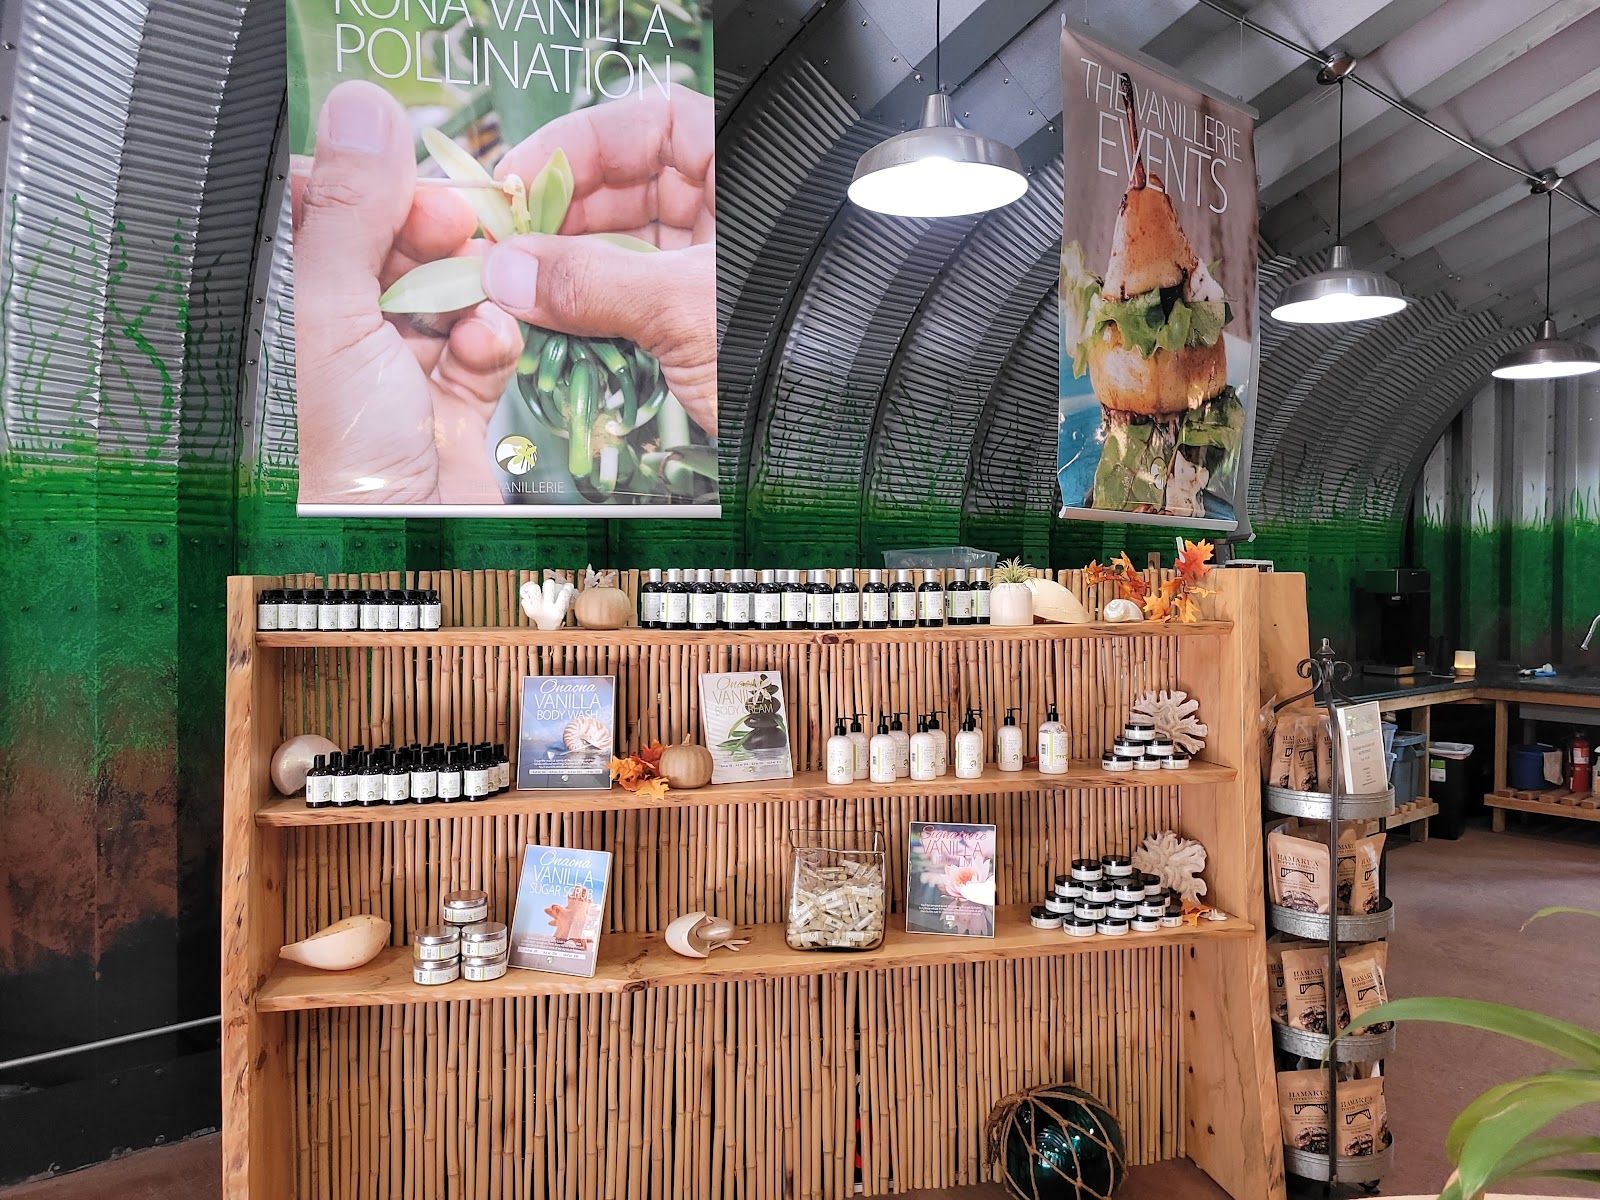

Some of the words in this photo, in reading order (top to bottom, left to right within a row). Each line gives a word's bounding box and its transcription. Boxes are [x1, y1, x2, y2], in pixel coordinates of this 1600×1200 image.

[490, 0, 675, 48] VANILLA
[335, 23, 672, 101] POLLINATION
[1080, 57, 1128, 114] THE
[1133, 80, 1243, 164] VANILLERIE
[1098, 110, 1228, 215] EVENTS
[498, 481, 565, 494] ANILLERIE
[534, 693, 602, 709] VANILLA
[536, 709, 566, 721] BODY
[568, 709, 598, 720] WASH
[921, 839, 984, 857] VANILLA
[533, 864, 595, 889] VANILLA
[529, 881, 561, 897] SUGAR
[563, 885, 593, 902] SCRUB
